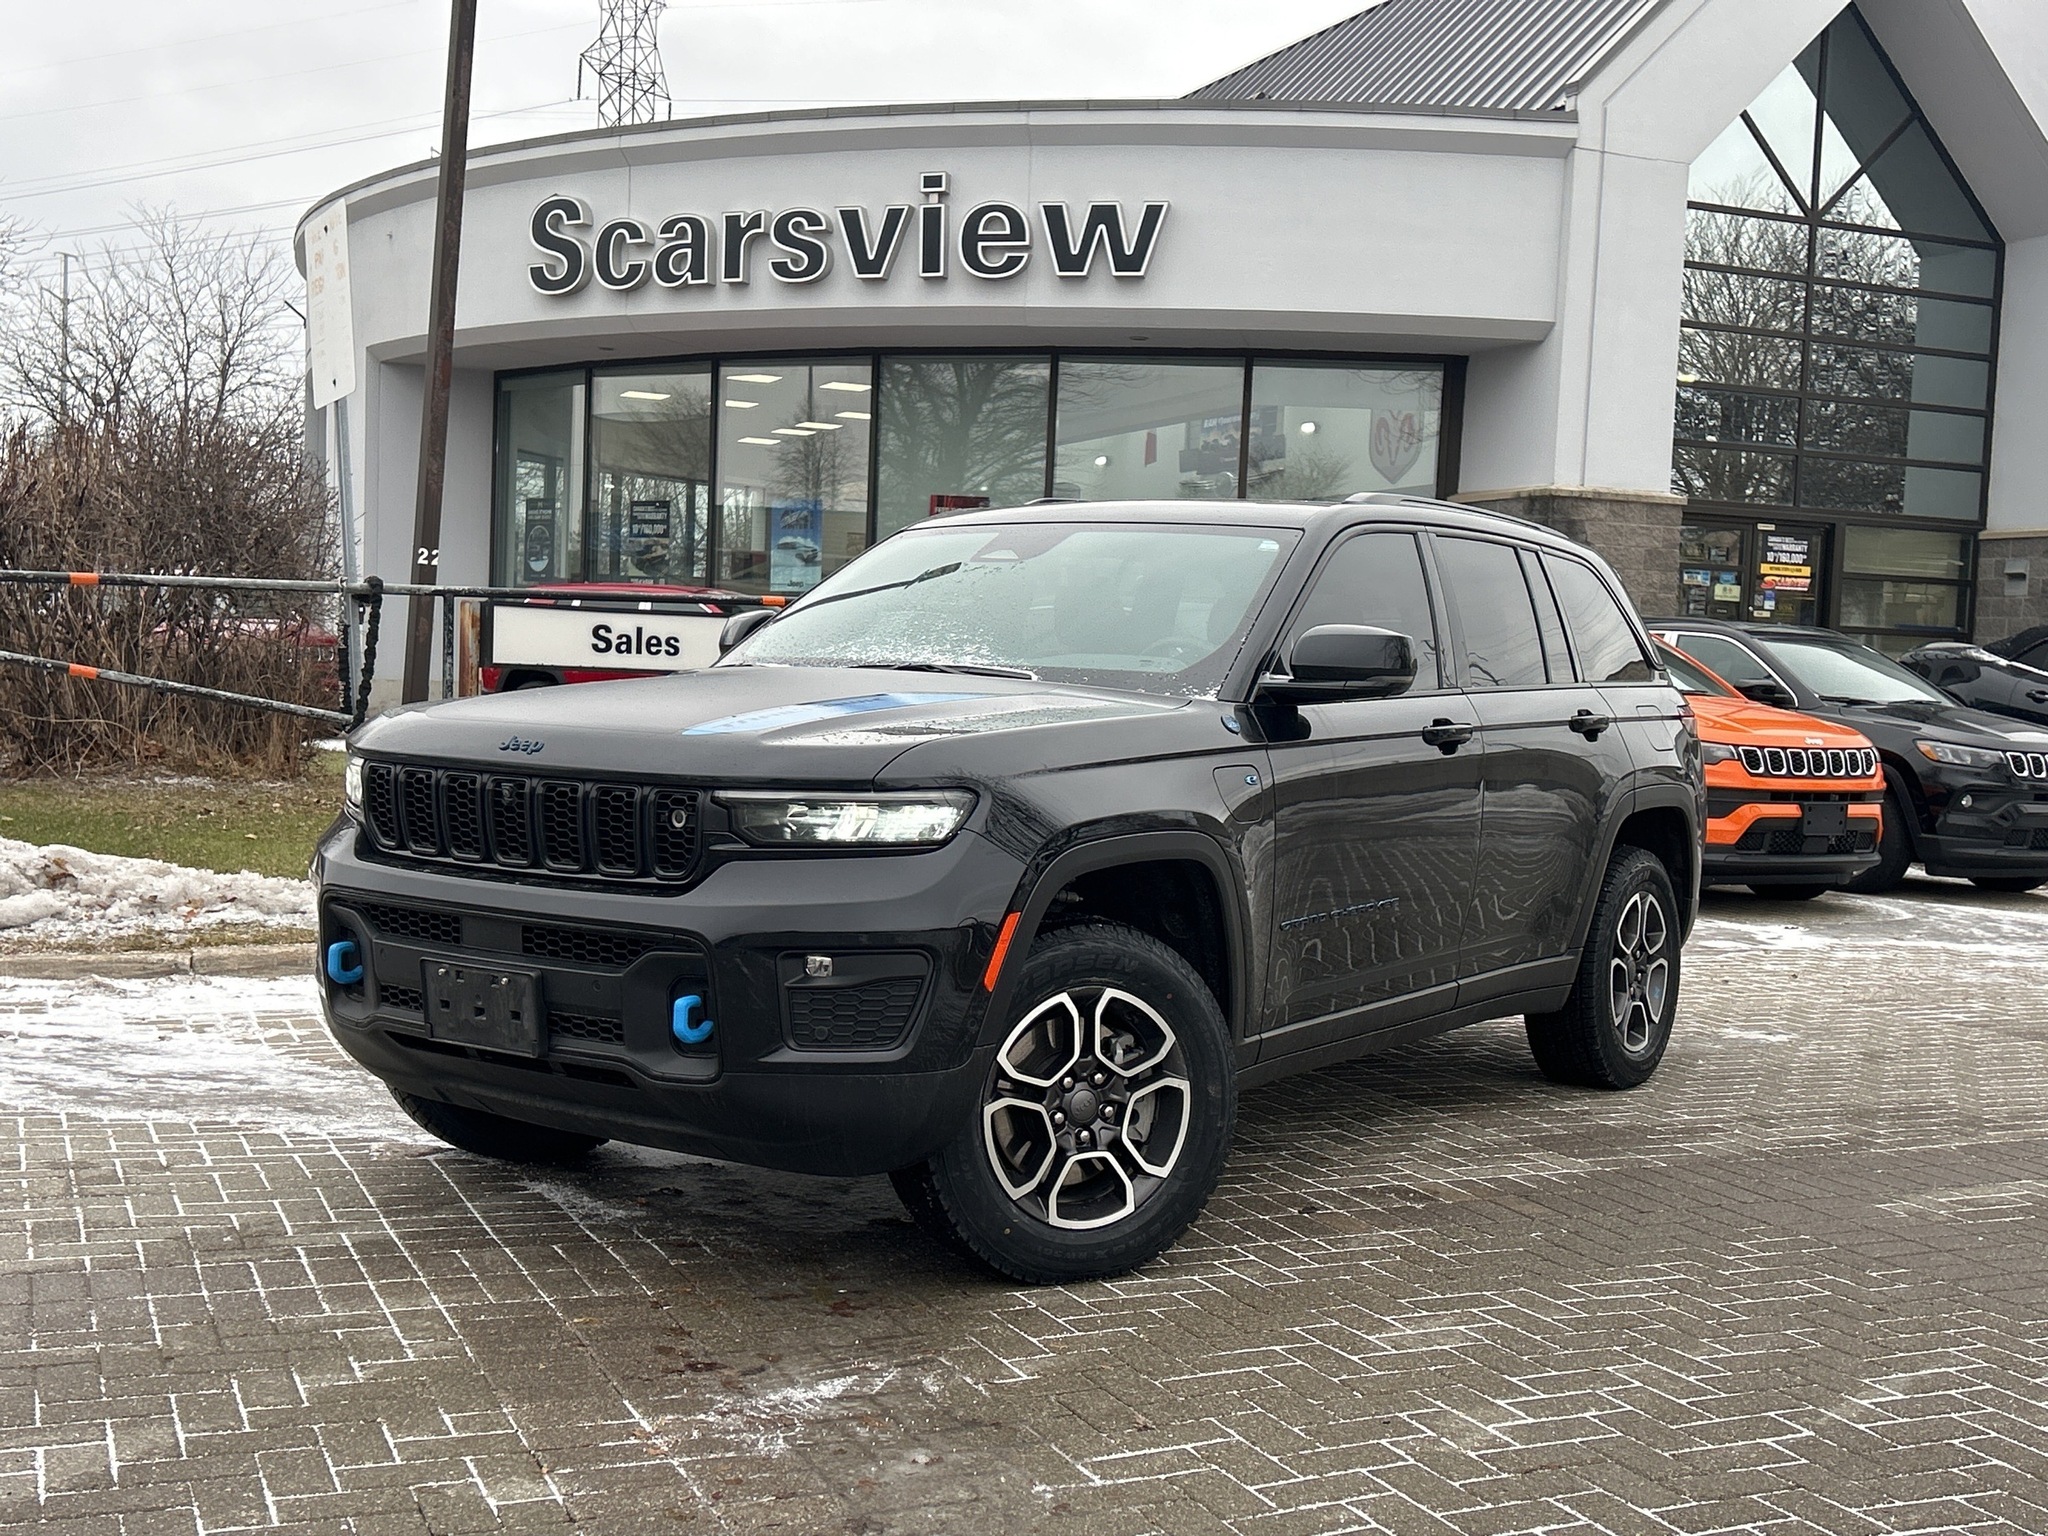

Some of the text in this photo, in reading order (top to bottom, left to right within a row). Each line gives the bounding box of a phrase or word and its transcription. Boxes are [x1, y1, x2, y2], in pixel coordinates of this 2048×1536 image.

[526, 171, 1170, 297] Scarsview
[591, 624, 680, 656] Sales
[499, 735, 545, 755] Jeep
